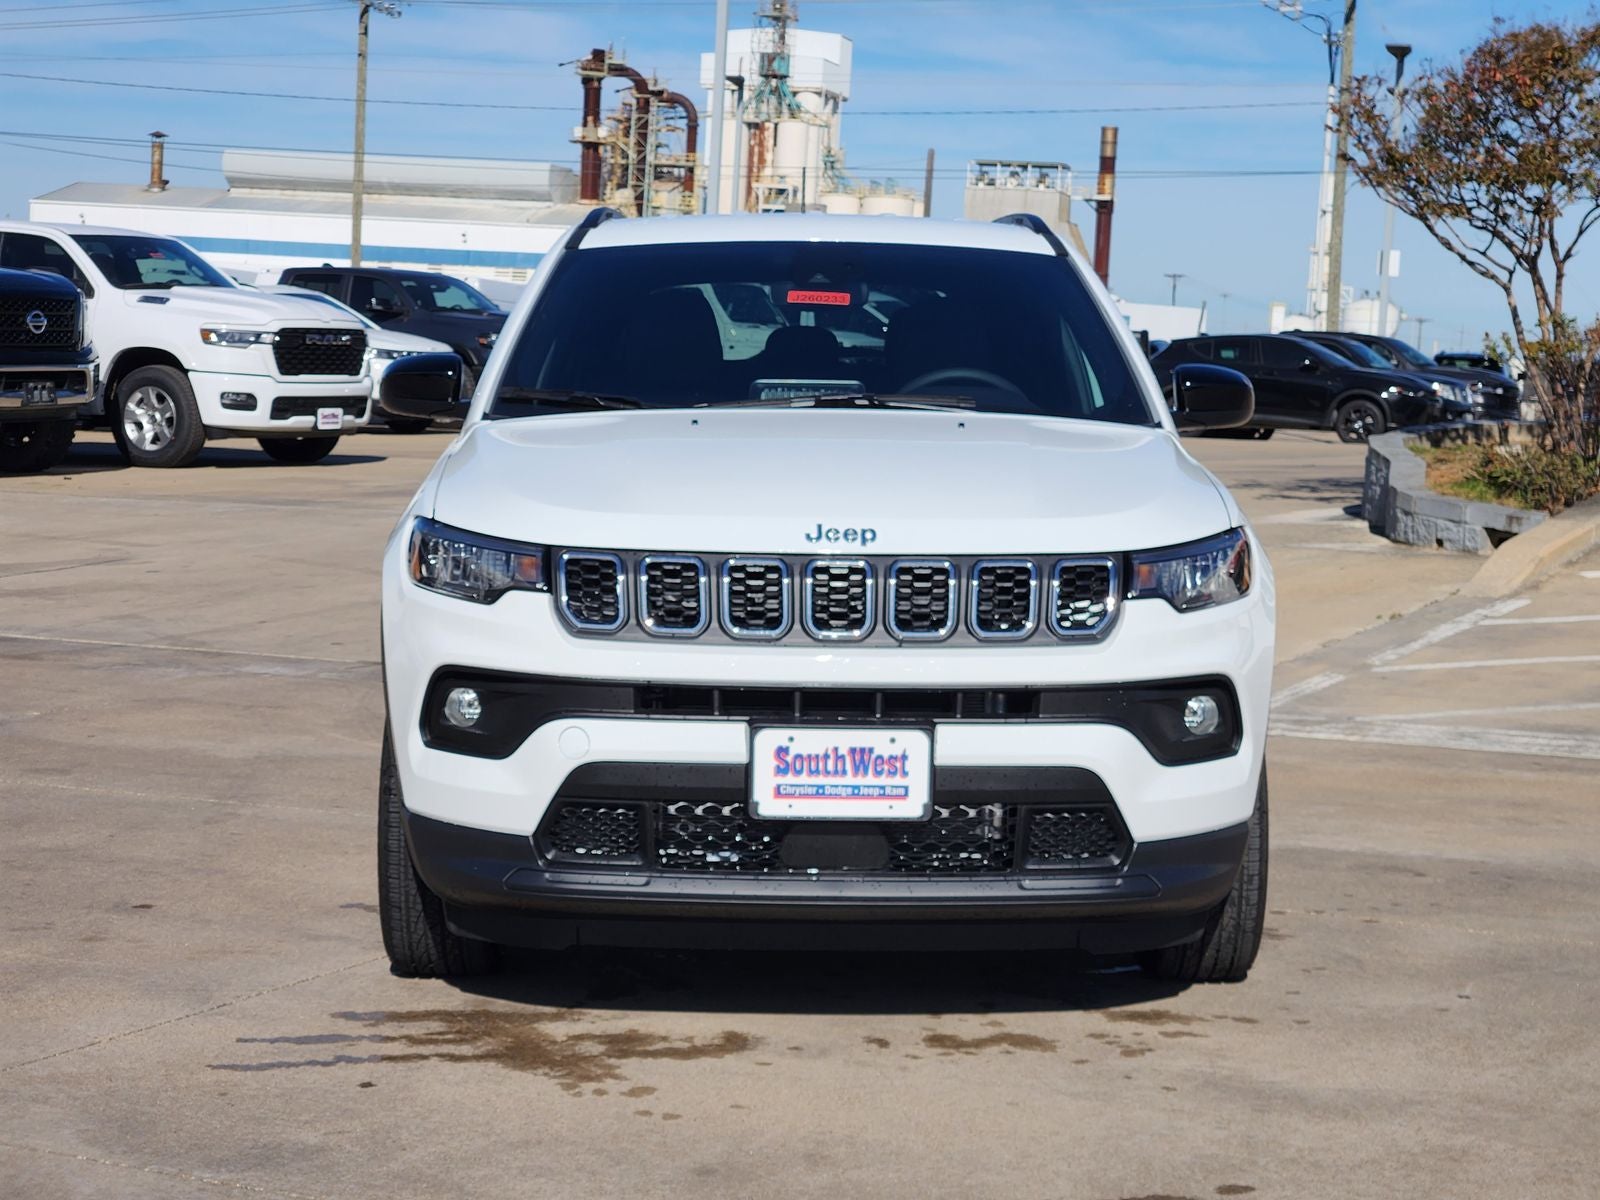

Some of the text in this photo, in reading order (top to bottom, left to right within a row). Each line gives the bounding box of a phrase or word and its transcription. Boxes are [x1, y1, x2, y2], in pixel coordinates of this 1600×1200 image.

[805, 523, 877, 547] Jeep
[780, 785, 905, 797] Chrysler Dodge Jeep Ram
